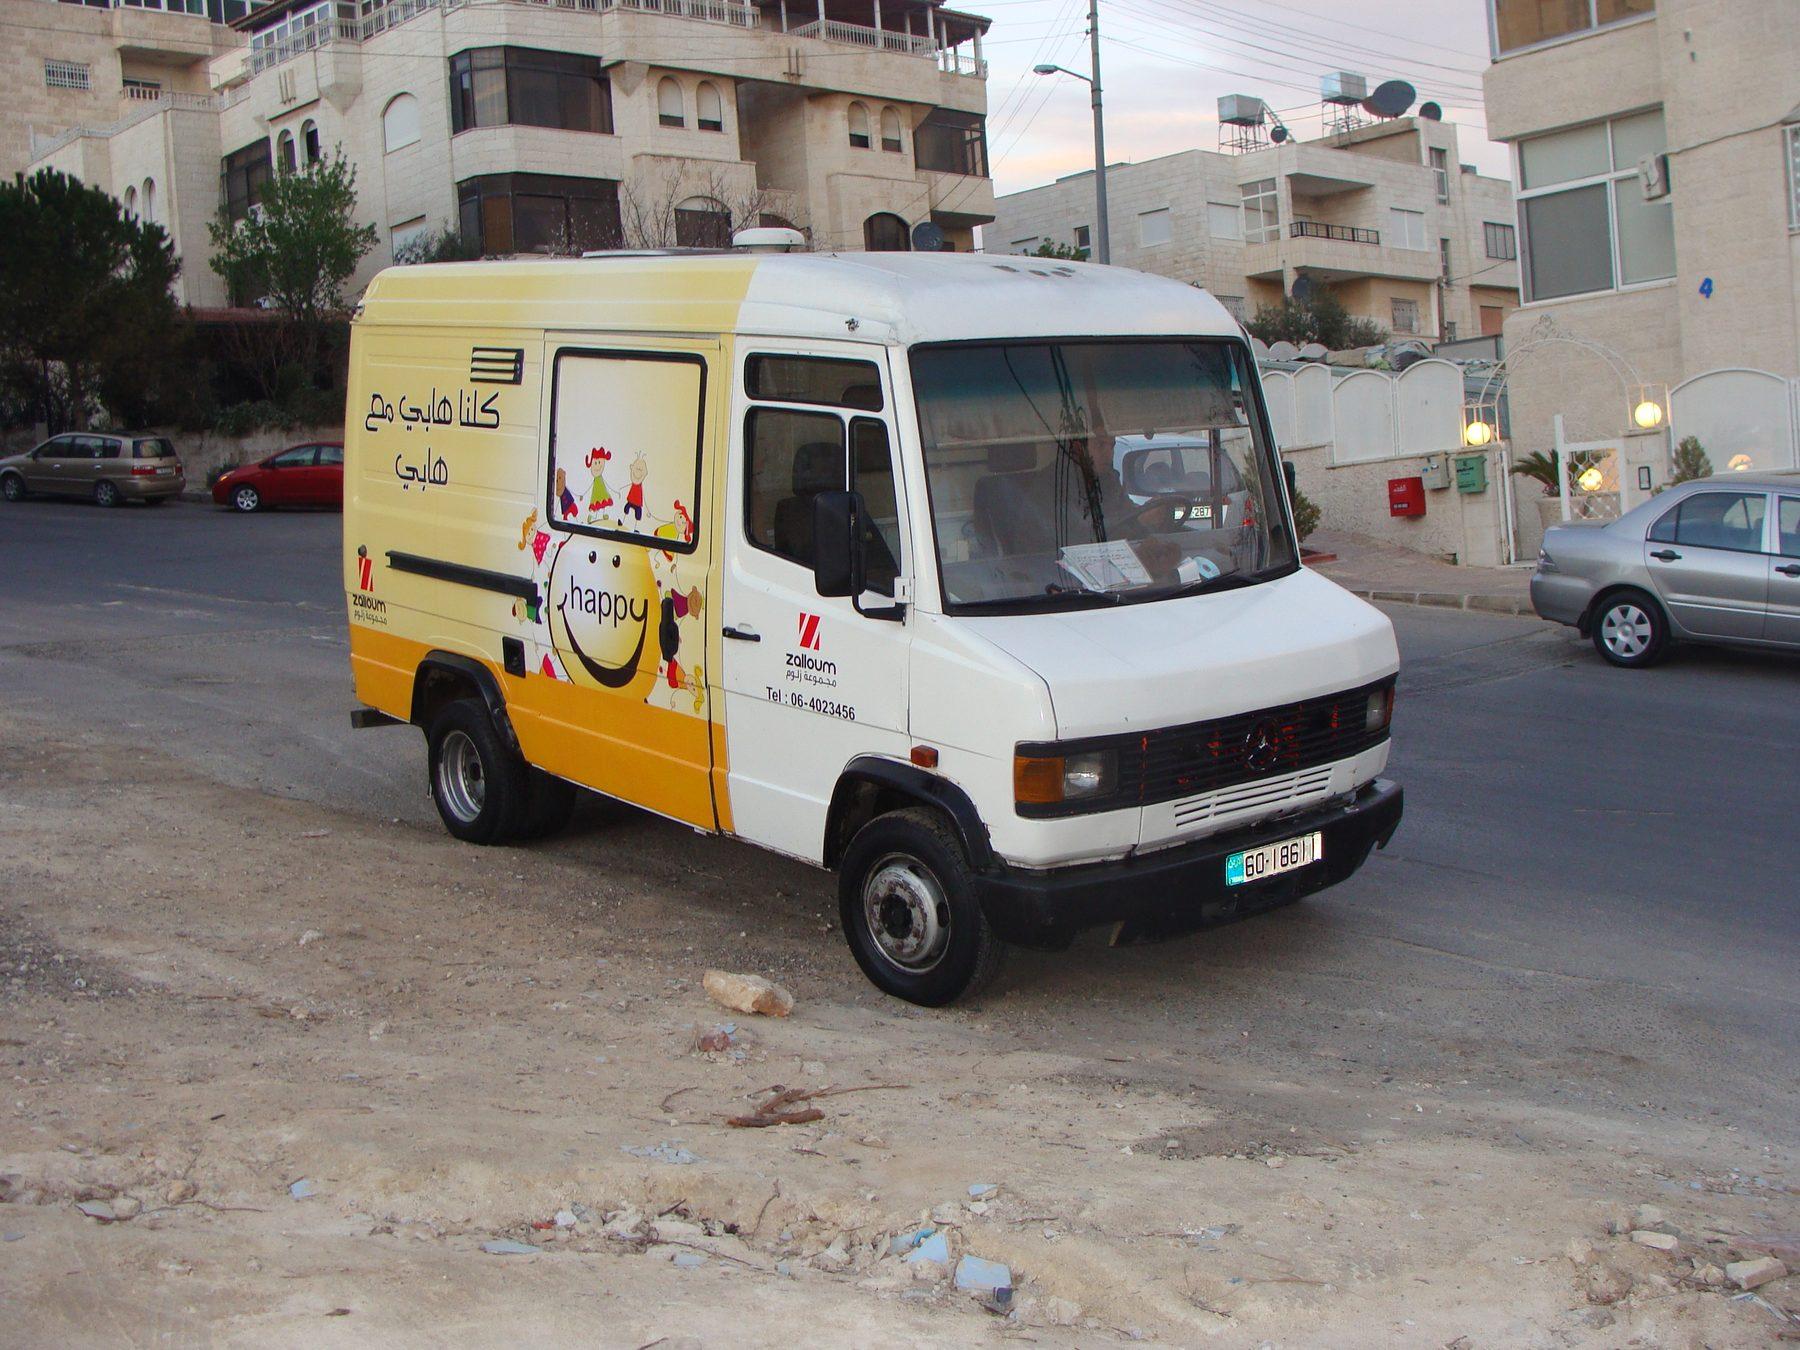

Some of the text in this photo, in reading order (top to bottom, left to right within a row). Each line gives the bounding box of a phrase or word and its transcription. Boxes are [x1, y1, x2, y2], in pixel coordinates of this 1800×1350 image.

[1699, 277, 1713, 298] 4
[365, 387, 500, 432] كلنا هابي مع
[395, 447, 448, 491] هابي
[352, 593, 387, 614] zalloum
[570, 575, 648, 627] happy
[786, 653, 837, 675] zalloum
[786, 670, 837, 688] مجموعة زلوم
[766, 686, 782, 703] Tel
[791, 692, 856, 721] 06-4023456
